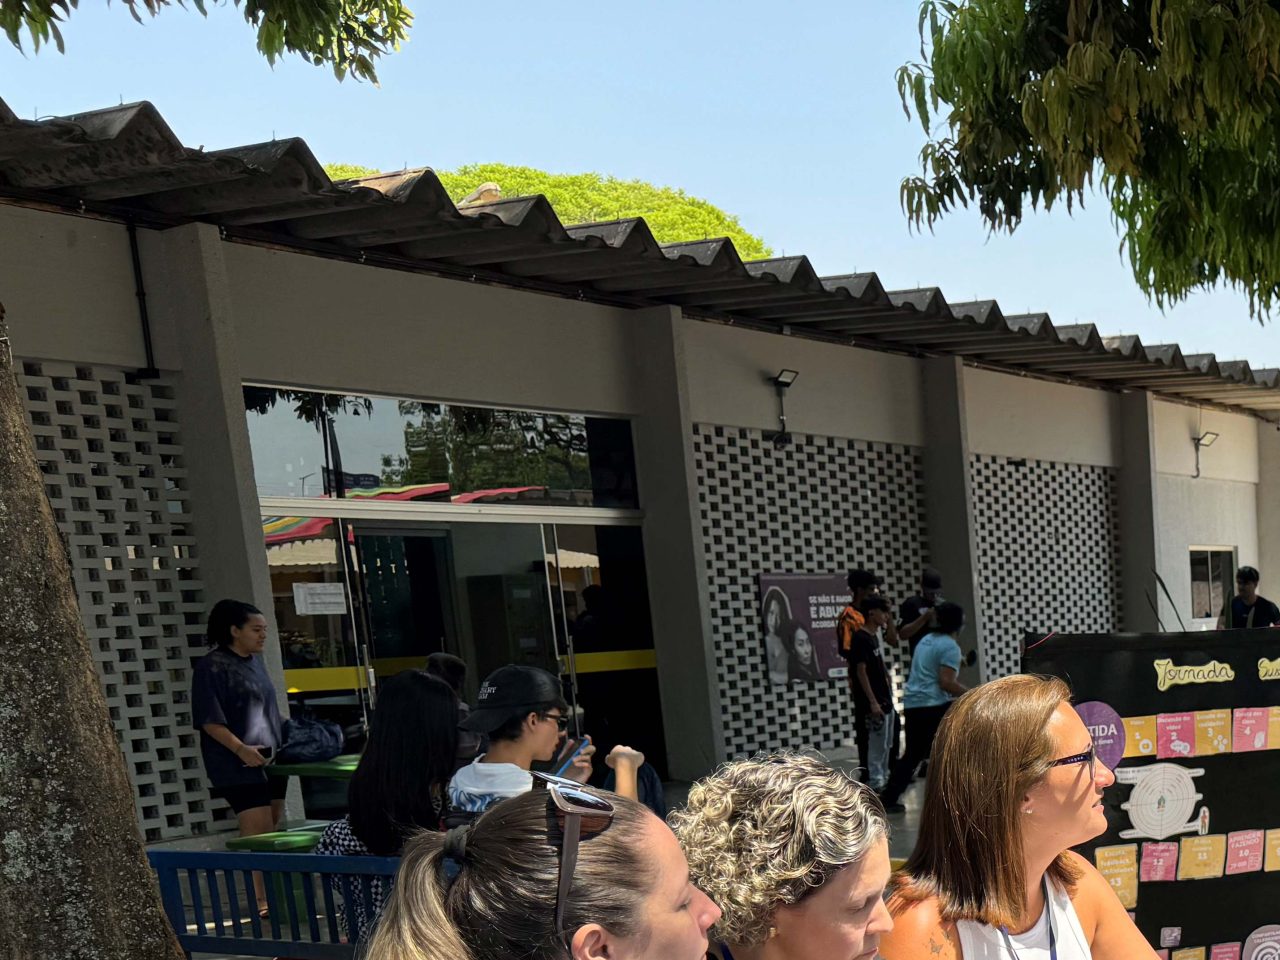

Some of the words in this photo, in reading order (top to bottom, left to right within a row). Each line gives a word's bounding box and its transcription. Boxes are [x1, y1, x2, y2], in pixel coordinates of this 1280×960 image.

[819, 606, 845, 618] ABUS
[1155, 660, 1232, 687] Jornada
[1089, 723, 1118, 737] TIDA
[1207, 728, 1213, 737] 3
[1244, 726, 1251, 736] 4
[1171, 732, 1177, 740] 2
[1239, 849, 1249, 857] 10
[1153, 858, 1164, 866] 12
[1109, 878, 1122, 887] 13
